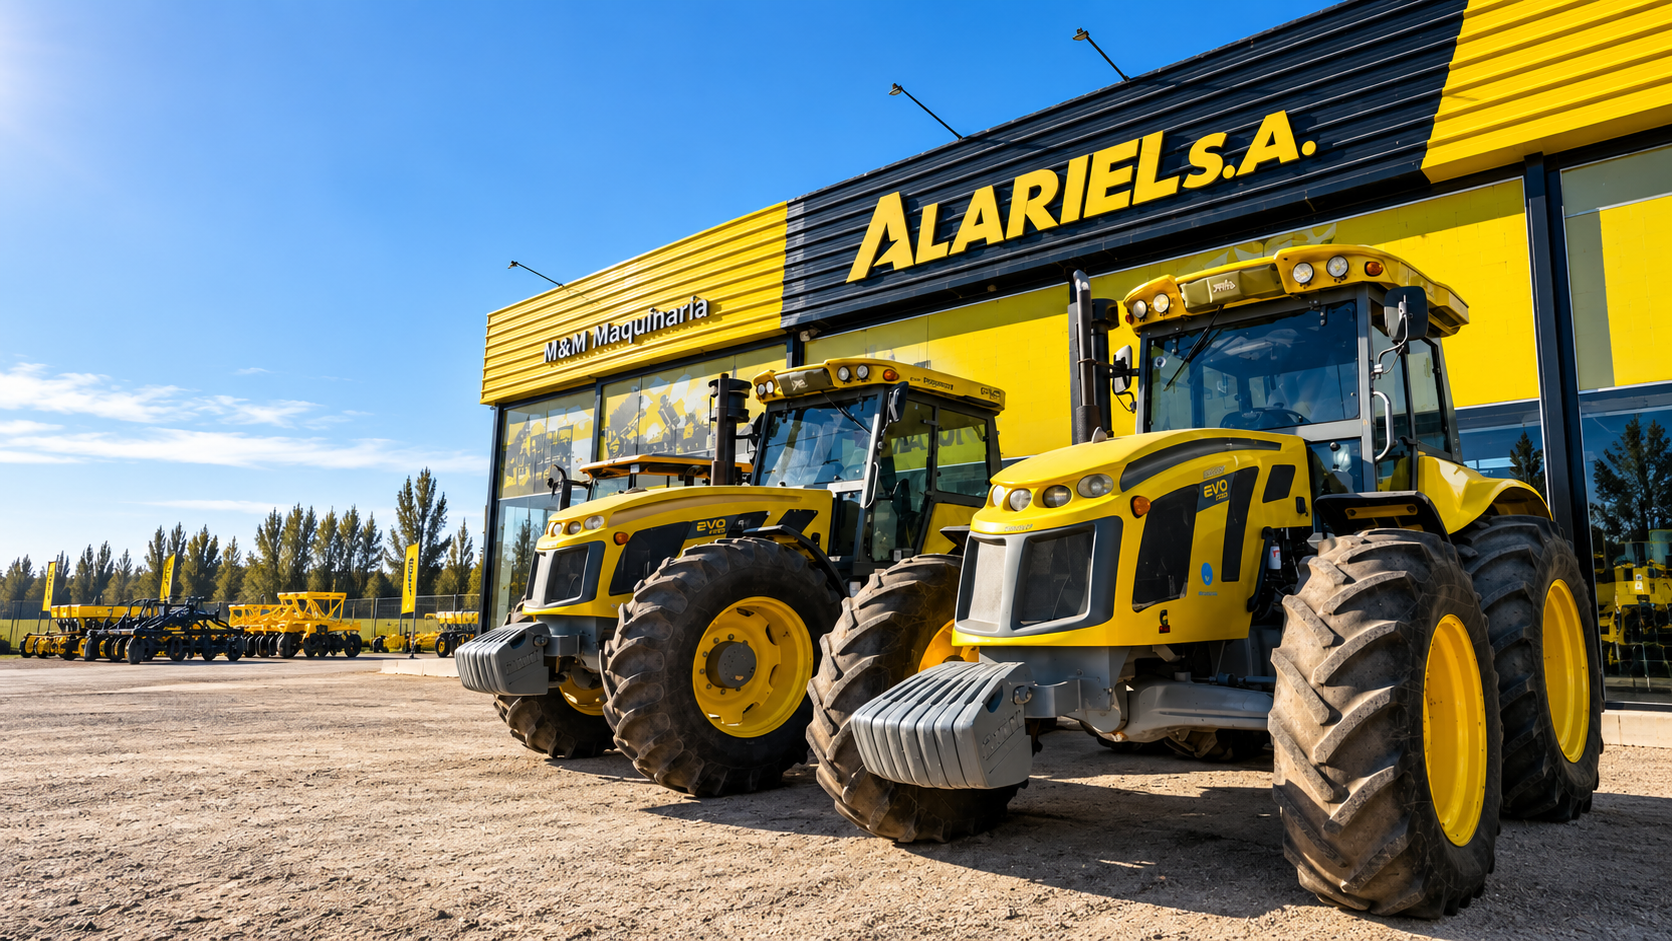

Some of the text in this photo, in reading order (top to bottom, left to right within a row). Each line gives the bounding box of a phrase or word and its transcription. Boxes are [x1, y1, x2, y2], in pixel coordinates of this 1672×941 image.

[846, 130, 1179, 283] ALARIEL
[543, 296, 709, 364] M&M Maquinaria
[1203, 479, 1228, 498] EVO
